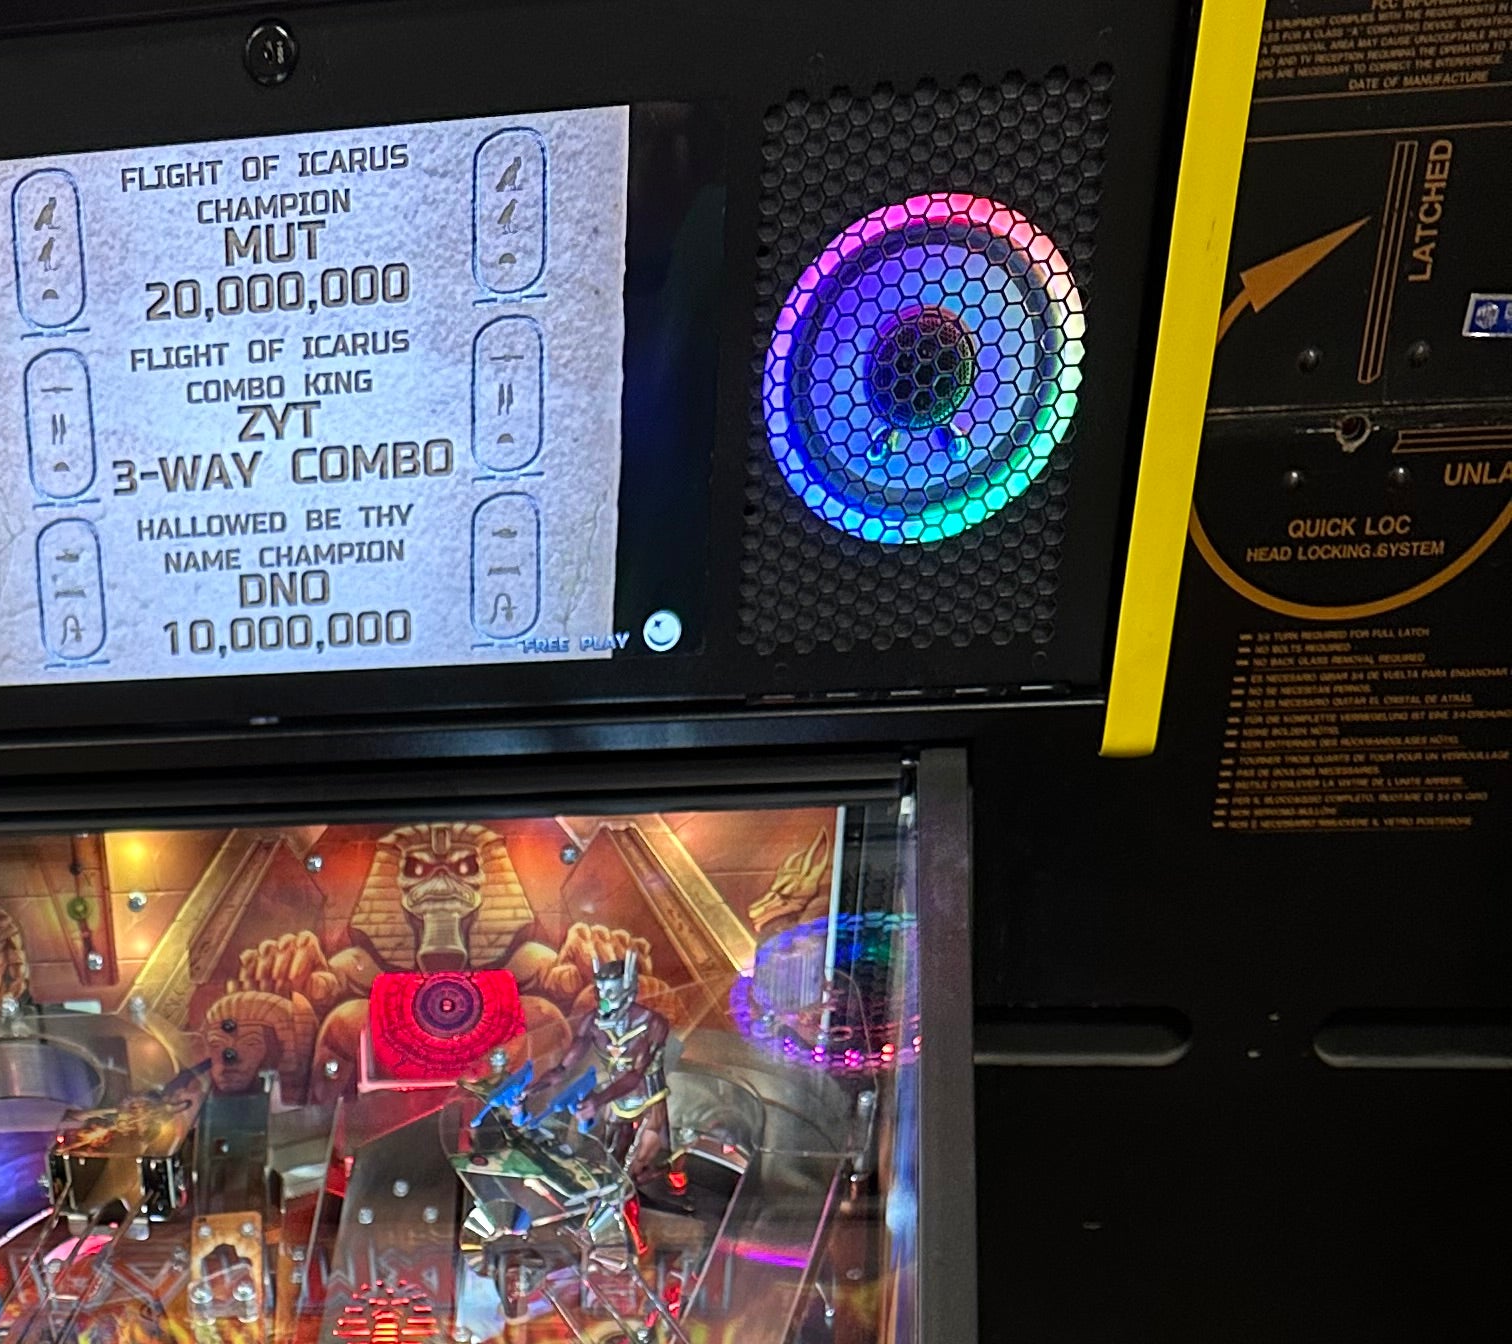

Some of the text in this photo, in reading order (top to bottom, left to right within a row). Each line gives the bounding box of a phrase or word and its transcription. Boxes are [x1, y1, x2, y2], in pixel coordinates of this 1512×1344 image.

[1348, 71, 1488, 91] DATE OF MANUFACTURE
[120, 143, 409, 194] FLIGHT OF ICARUS
[197, 188, 352, 225] CHAMPION
[1408, 139, 1453, 283] LATCHED
[224, 221, 326, 266] MUT
[144, 263, 410, 322] 20,000,000
[129, 329, 410, 373] FLIGHT OF ICARUS
[185, 369, 373, 404] COMBO KING
[237, 401, 321, 442] ZYT
[112, 438, 455, 496] 3-WAY COMBO
[136, 503, 415, 543] HALLOWED BE THY
[1288, 515, 1411, 539] QUICK LOC
[164, 539, 406, 575] NAME CHAMPION
[1246, 541, 1445, 563] HEAD LOCKING SYSTEM
[237, 569, 330, 608] DNO
[162, 609, 412, 659] 10,000,000
[522, 630, 630, 655] FREE PLAY
